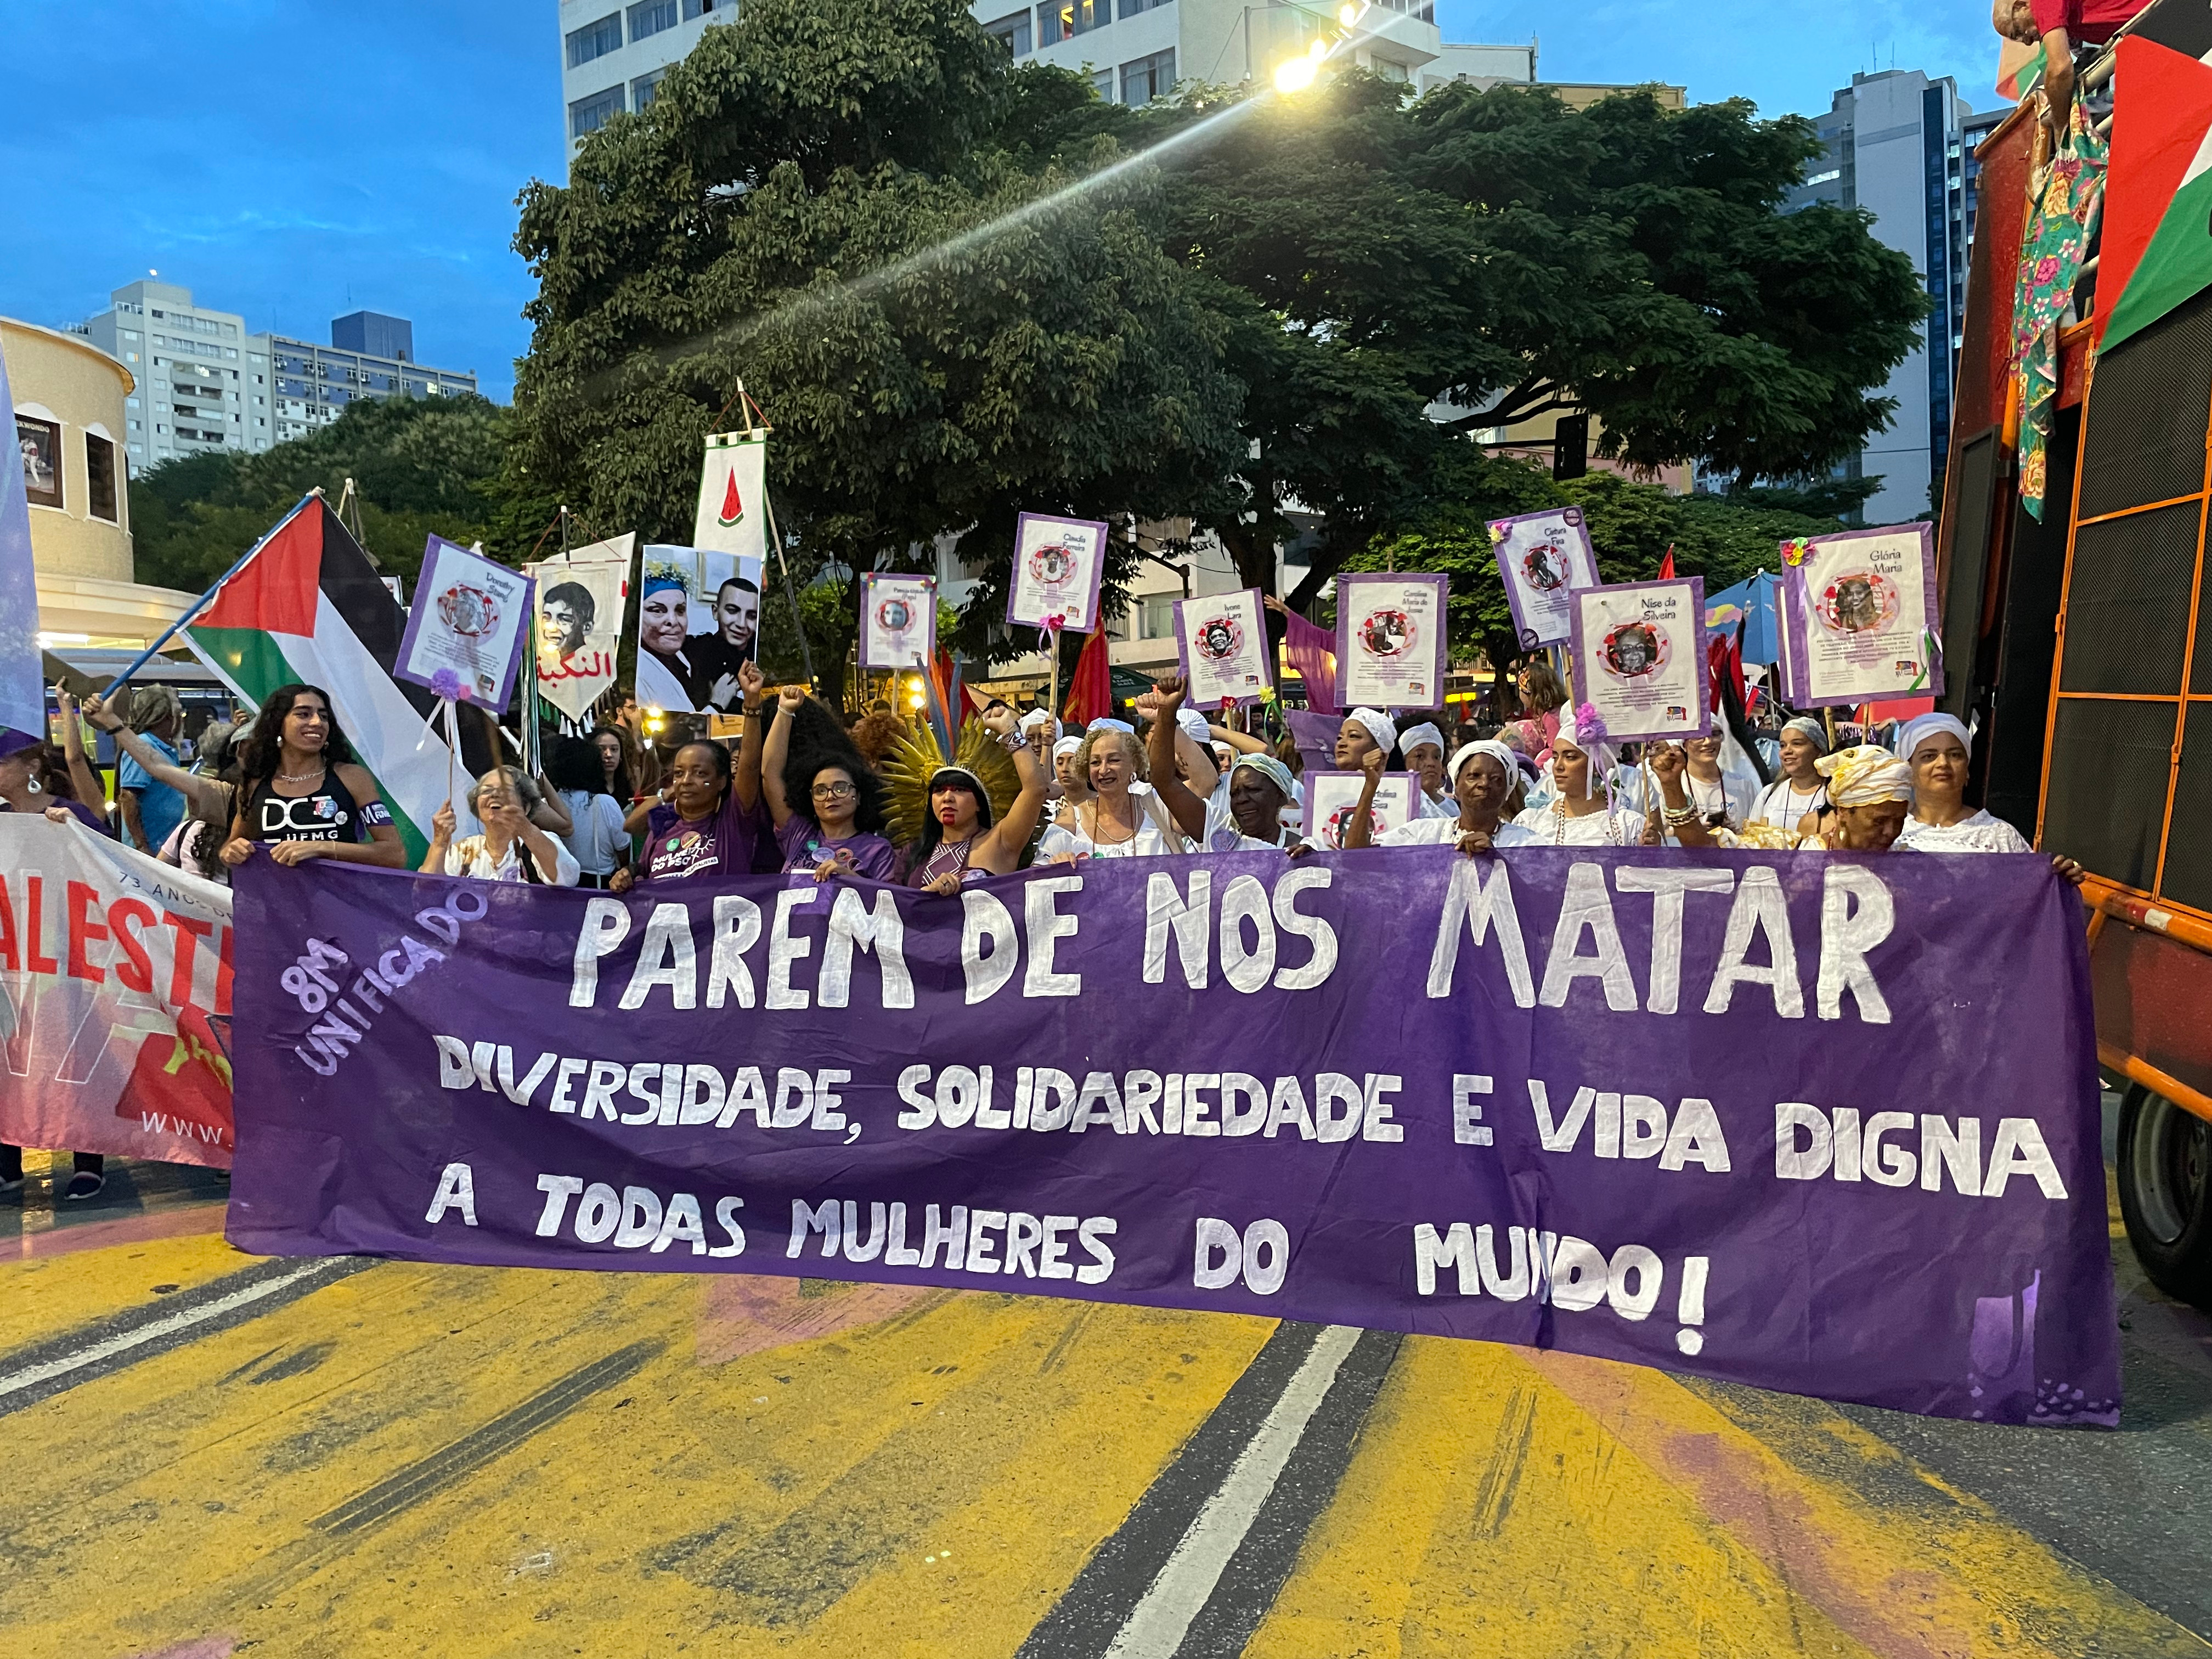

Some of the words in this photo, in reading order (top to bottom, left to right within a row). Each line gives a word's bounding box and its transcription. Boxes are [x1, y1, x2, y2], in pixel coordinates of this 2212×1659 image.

[1870, 549, 1901, 561] Glória
[1873, 562, 1903, 574] Maria
[486, 572, 515, 592] Dorothy
[1641, 599, 1662, 609] Nise
[1664, 597, 1677, 607] da
[1643, 610, 1677, 621] Silveira
[286, 830, 338, 842] UFMG
[120, 872, 140, 888] 73
[569, 887, 915, 1011] PAREM
[961, 874, 1084, 1005] DE
[1142, 867, 1338, 994] NOS
[1427, 855, 1896, 1025] MATAR
[280, 938, 348, 1013] 8M
[295, 892, 488, 1076] UNIFICADO
[432, 1035, 862, 1144] DIVERSIDADE,
[898, 1064, 1404, 1144] SOLIDARIEDADE
[1453, 1073, 1493, 1147] E
[1527, 1079, 1731, 1173] VIDA
[1775, 1102, 2069, 1200] DIGNA
[425, 1161, 478, 1226] A
[535, 1173, 746, 1259] TODAS
[786, 1199, 1118, 1285] MULHERES
[1193, 1217, 1290, 1295] DO
